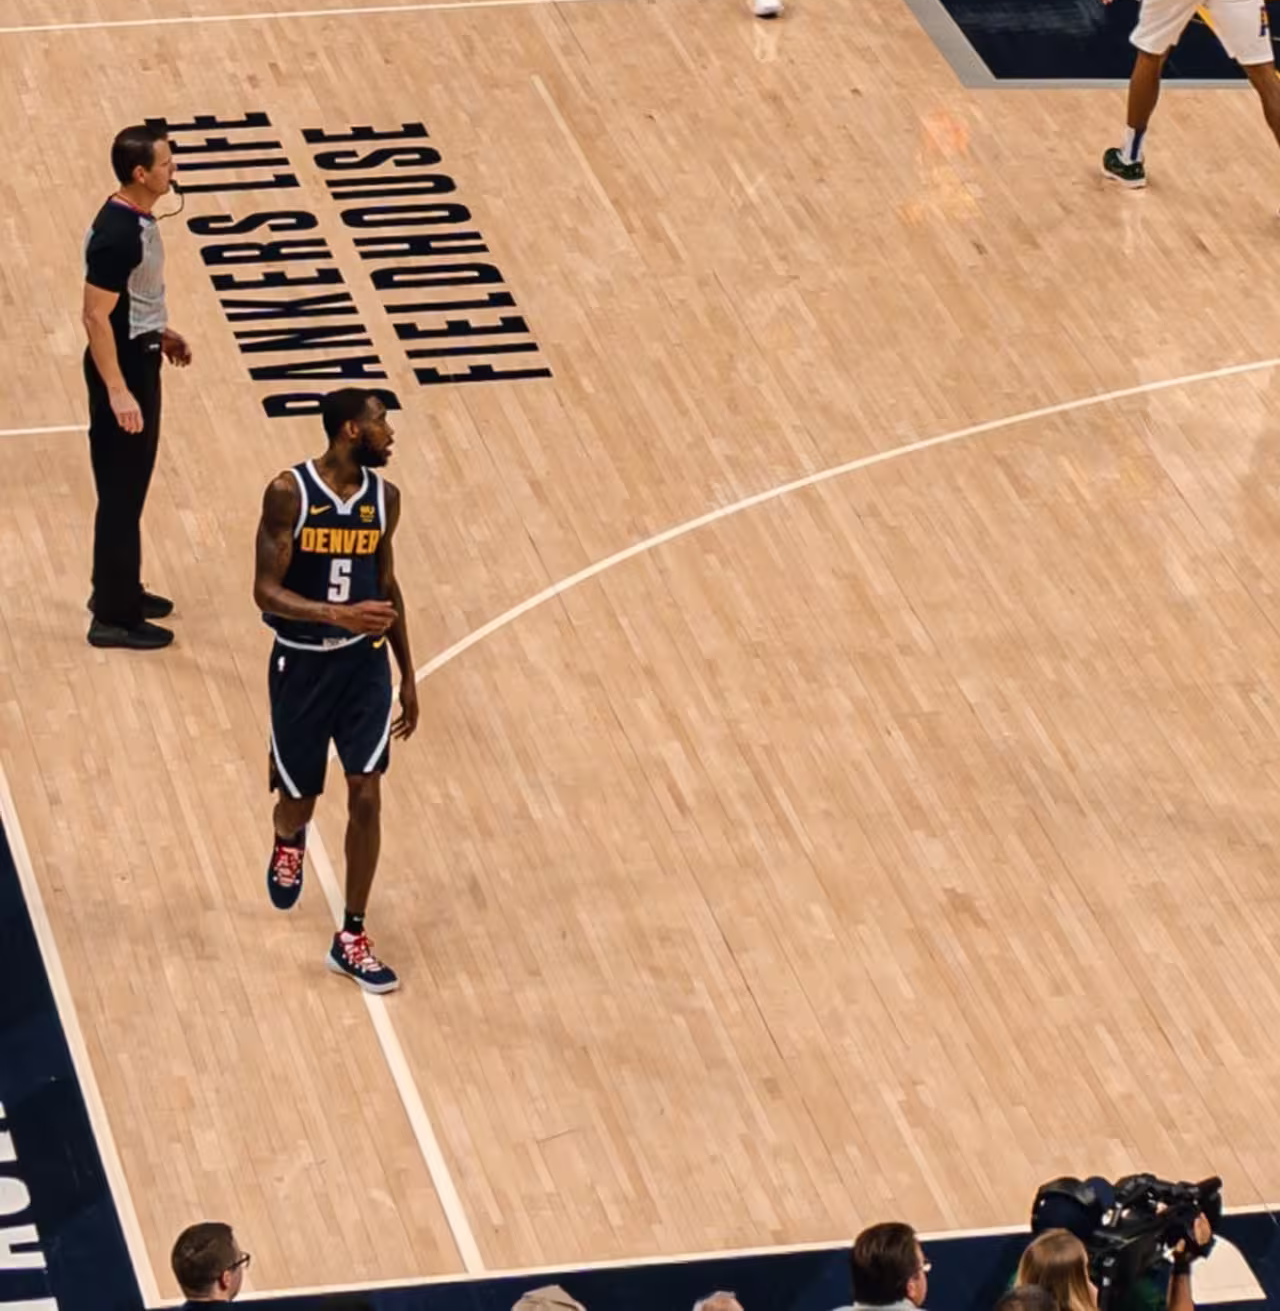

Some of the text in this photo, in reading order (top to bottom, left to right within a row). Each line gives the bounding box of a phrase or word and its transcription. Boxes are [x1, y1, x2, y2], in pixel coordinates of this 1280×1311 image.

[144, 110, 301, 195] LIFE
[300, 121, 554, 387] FIELDHOUSE
[301, 526, 381, 555] DENVER
[327, 557, 352, 603] 5
